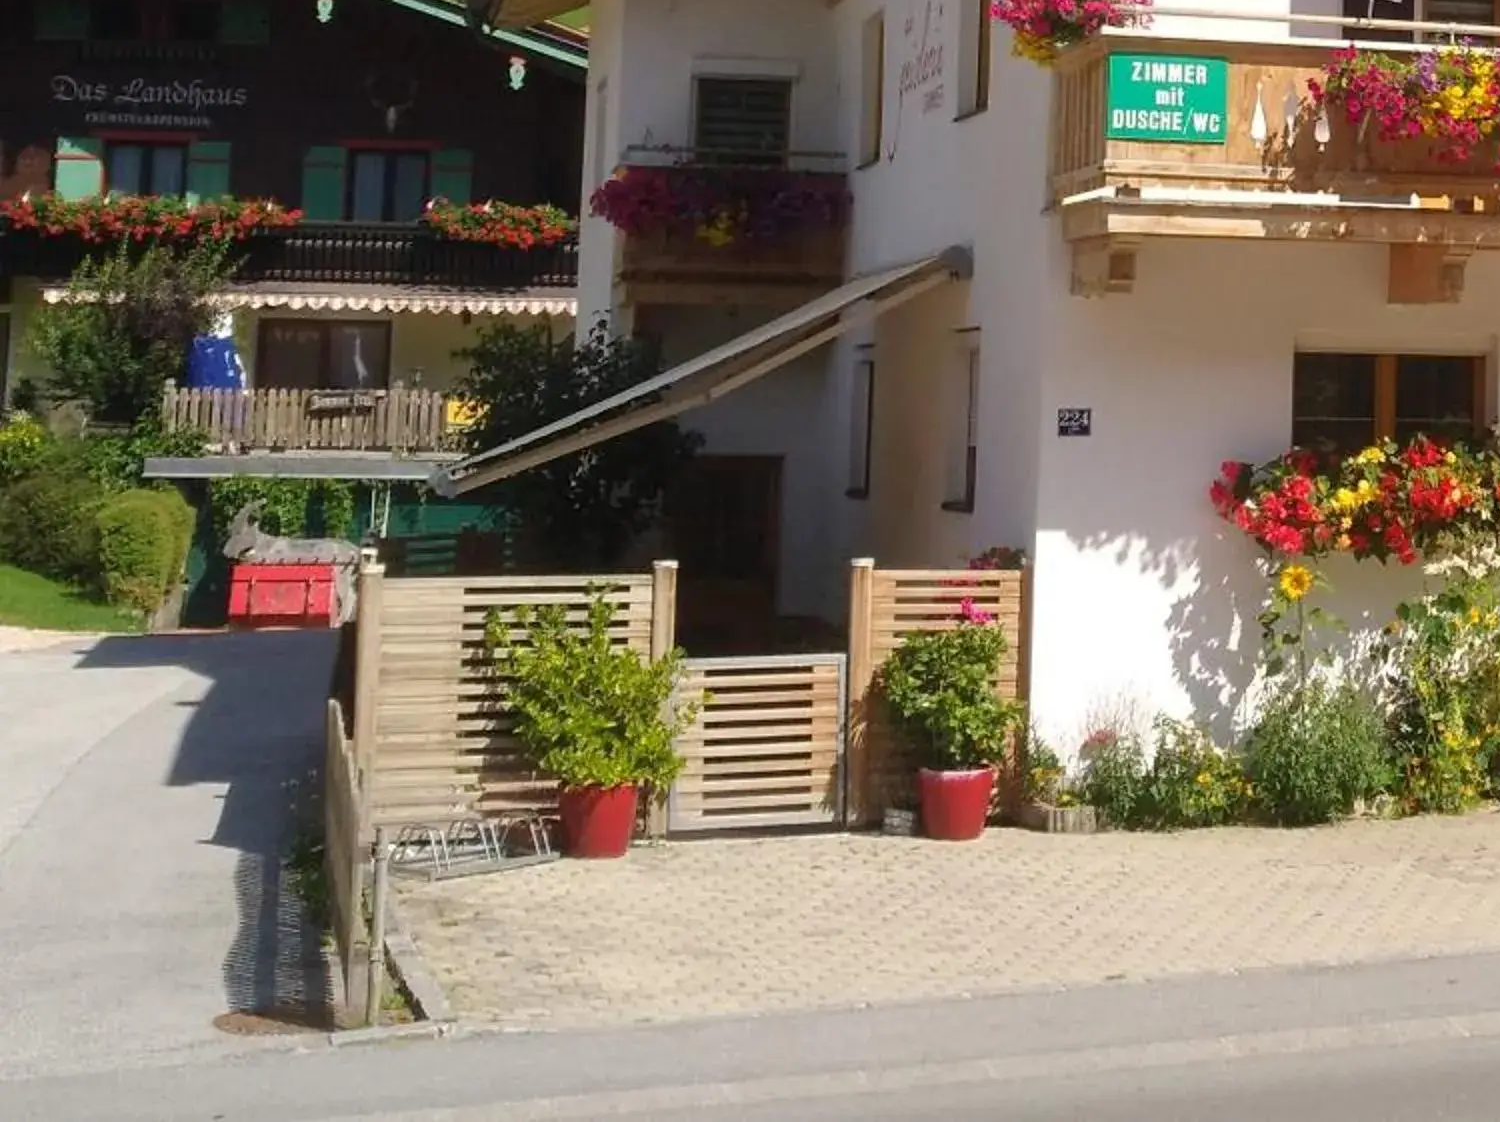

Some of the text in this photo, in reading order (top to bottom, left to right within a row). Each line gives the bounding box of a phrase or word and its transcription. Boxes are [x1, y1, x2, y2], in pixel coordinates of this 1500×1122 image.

[1131, 61, 1208, 84] ZIMMER
[51, 75, 248, 108] Das Landhaus
[1154, 86, 1185, 106] mit
[1112, 108, 1221, 134] DUSCHE/WC
